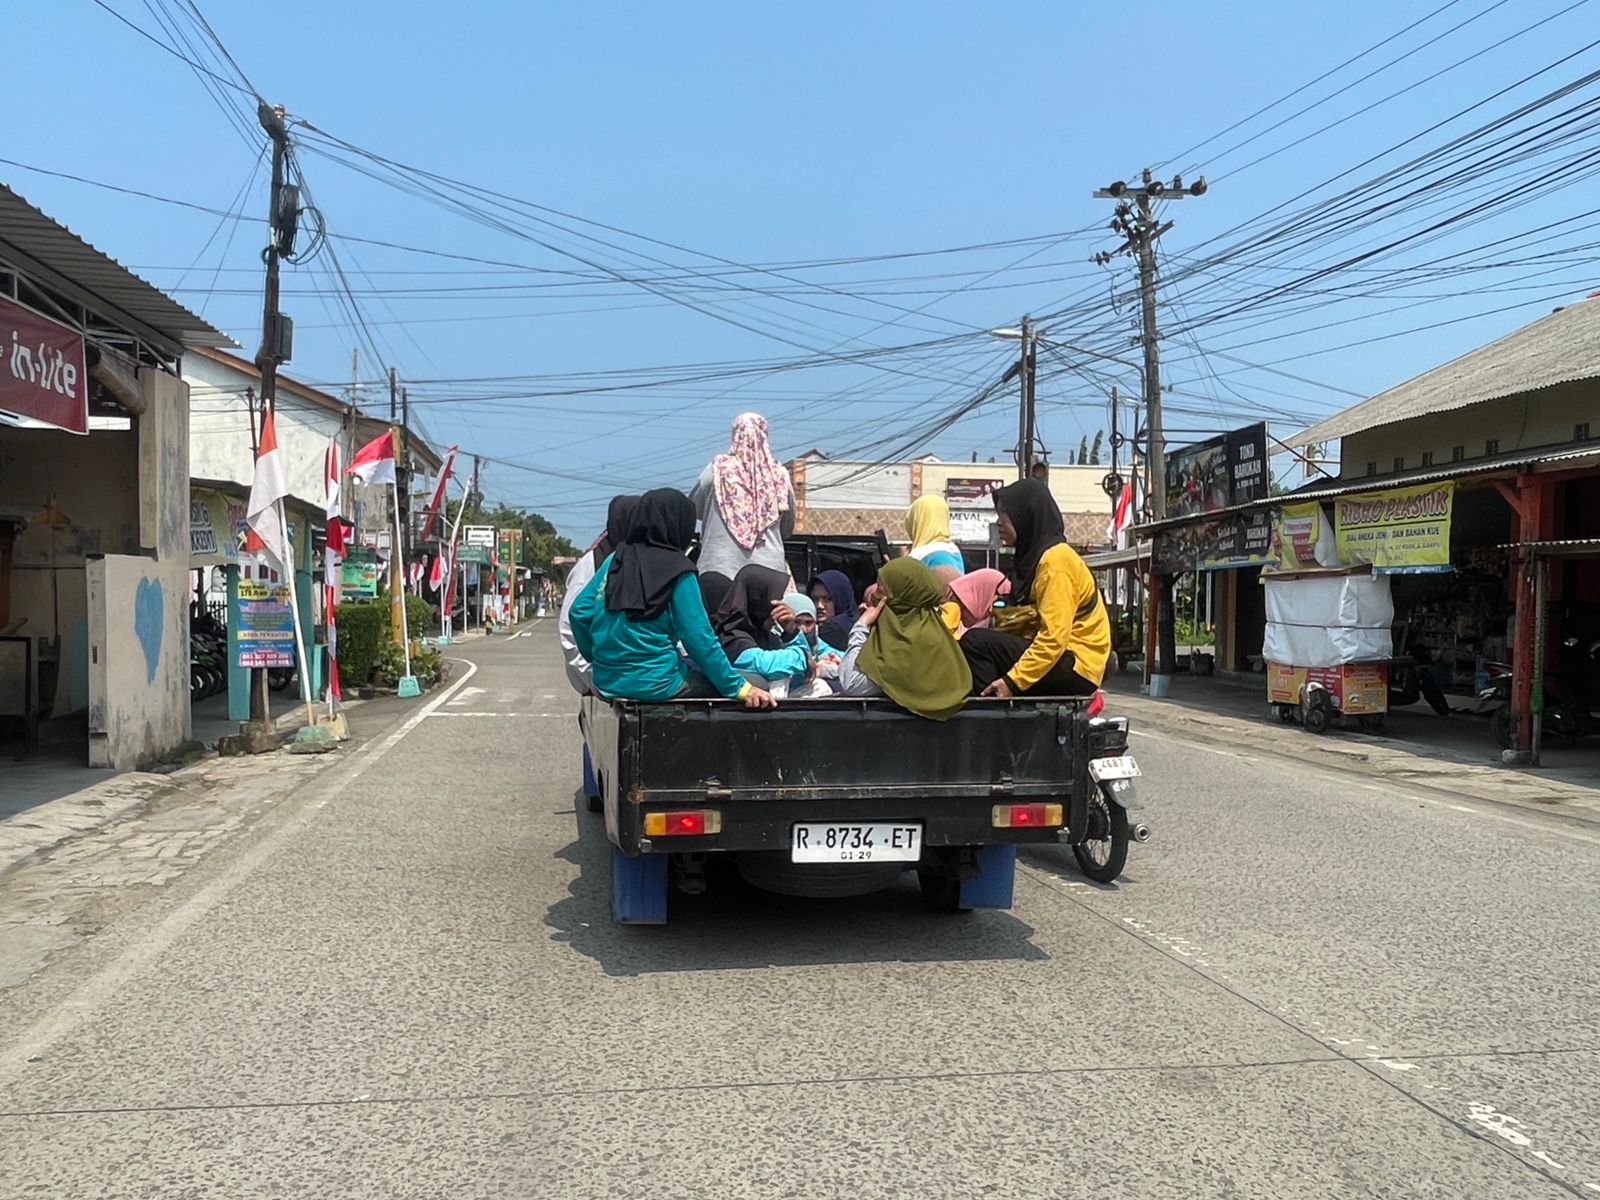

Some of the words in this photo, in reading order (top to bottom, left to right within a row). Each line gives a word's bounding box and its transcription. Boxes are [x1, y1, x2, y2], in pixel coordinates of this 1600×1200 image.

[1384, 489, 1448, 520] PLASTIK
[1392, 530, 1404, 538] DAN
[1405, 528, 1425, 537] BAHAN
[1427, 526, 1440, 535] KUE
[797, 827, 809, 849] R
[826, 827, 874, 849] 8734
[892, 827, 917, 849] ET
